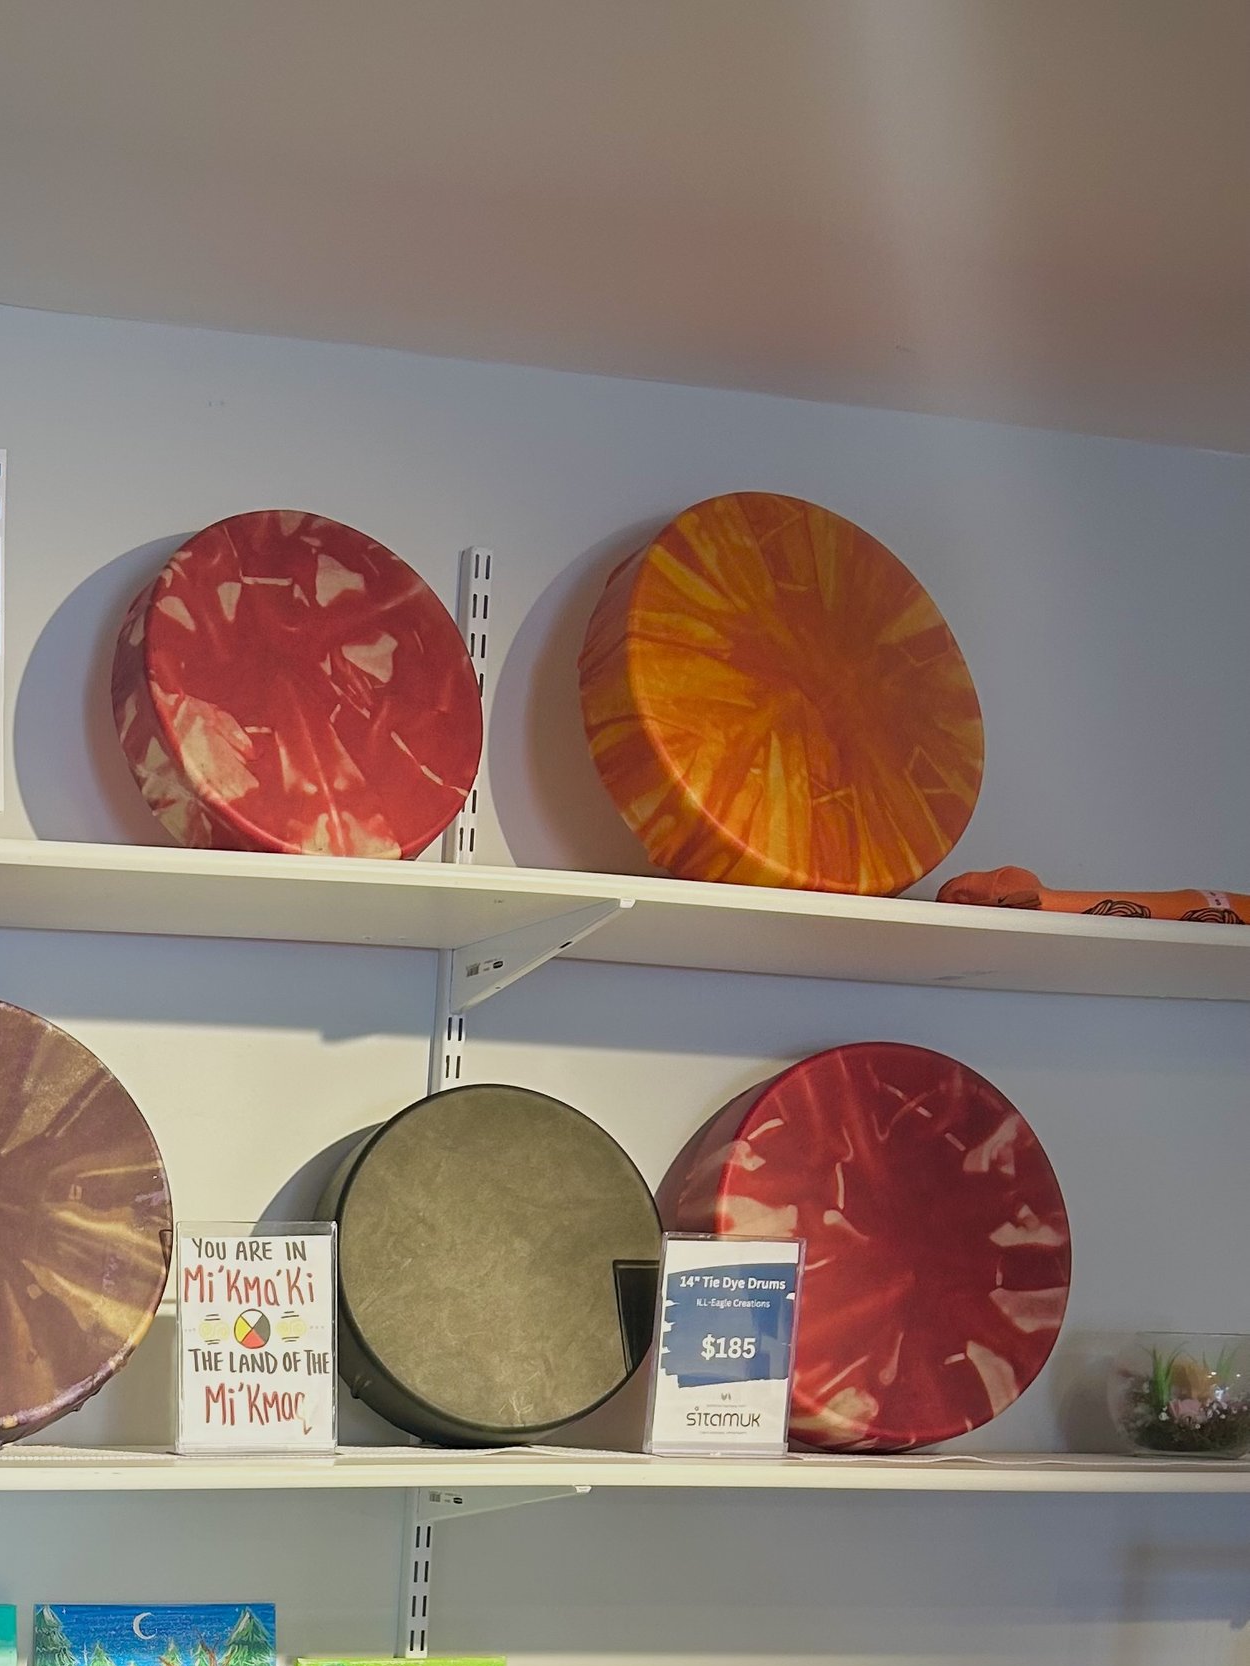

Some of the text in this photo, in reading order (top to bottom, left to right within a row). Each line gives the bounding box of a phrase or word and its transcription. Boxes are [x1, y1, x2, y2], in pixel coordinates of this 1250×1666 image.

[192, 1238, 307, 1261] YOU ARE IN
[679, 1275, 786, 1291] 14" Tie Dye Drums
[696, 1298, 771, 1308] ILL-Eagle Creations
[701, 1334, 756, 1360] $185
[188, 1349, 330, 1376] THE LAND OF THE
